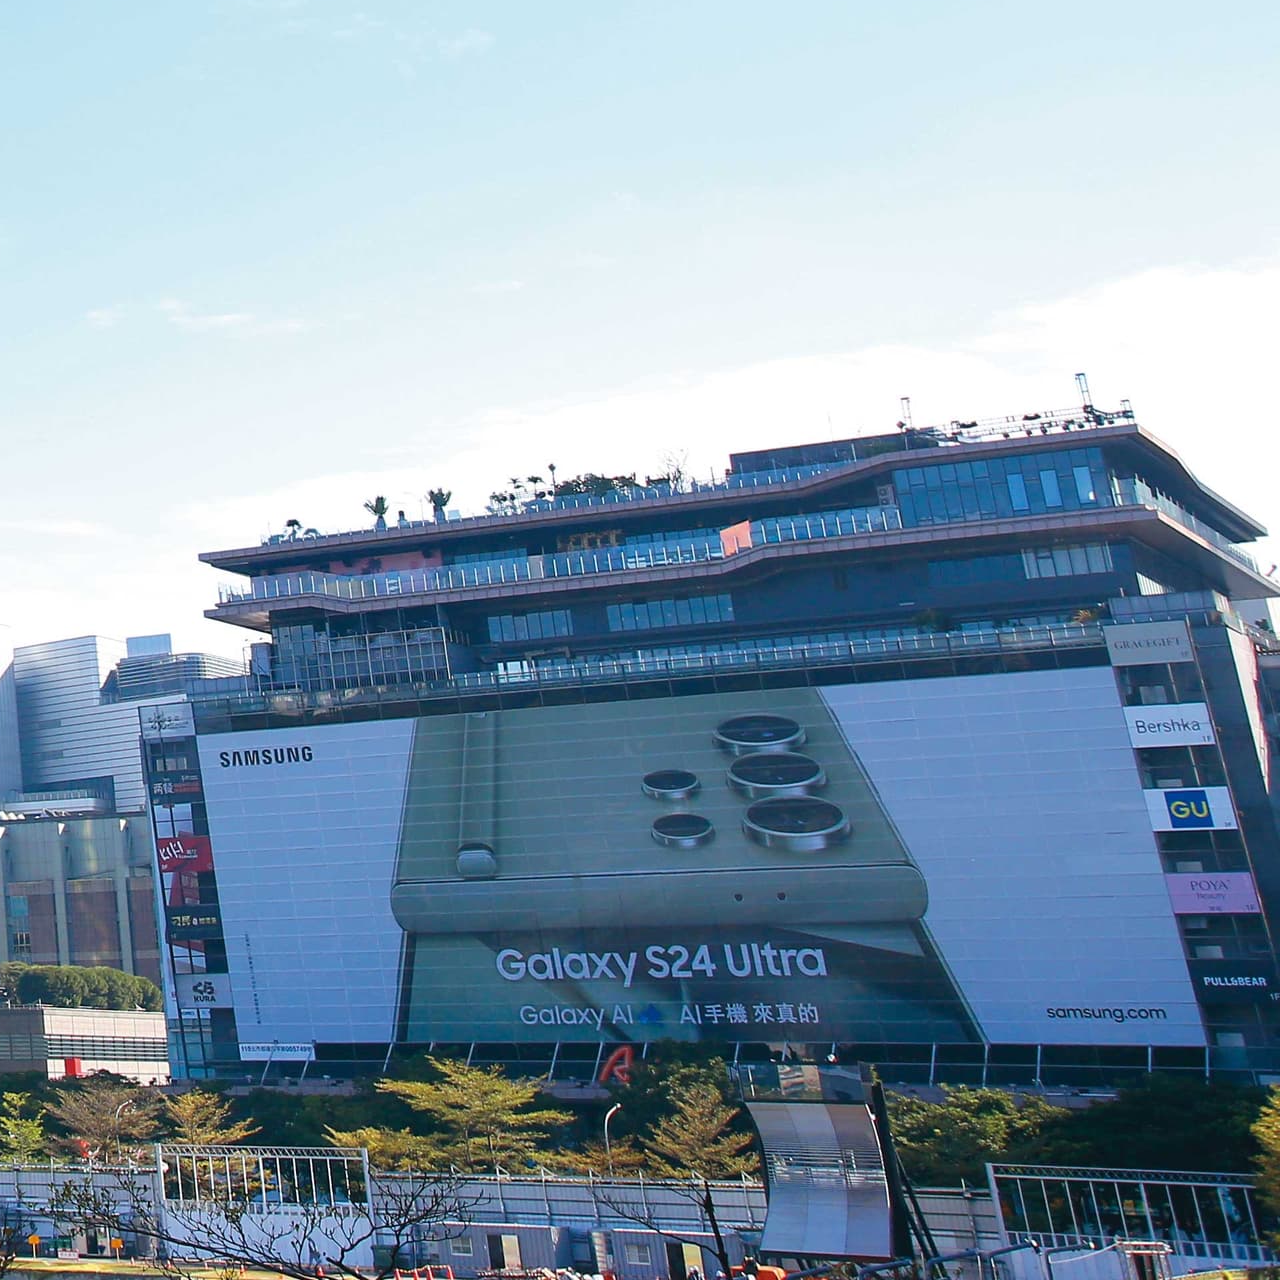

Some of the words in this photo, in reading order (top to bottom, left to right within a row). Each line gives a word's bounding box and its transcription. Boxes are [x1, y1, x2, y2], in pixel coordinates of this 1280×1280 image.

[1136, 718, 1201, 734] Bershka
[219, 745, 313, 768] SAMSUNG
[1170, 801, 1209, 819] GU
[1190, 880, 1229, 891] POYA
[496, 948, 637, 987] Galaxy
[645, 945, 716, 979] S24
[724, 942, 828, 977] Ultra
[1203, 977, 1267, 987] PULL&BEAR
[193, 995, 216, 1003] KURA
[520, 1005, 604, 1031] Galaxy
[612, 1004, 633, 1025] AI
[753, 1002, 820, 1024] 來真的
[1047, 1006, 1167, 1023] samsung.com
